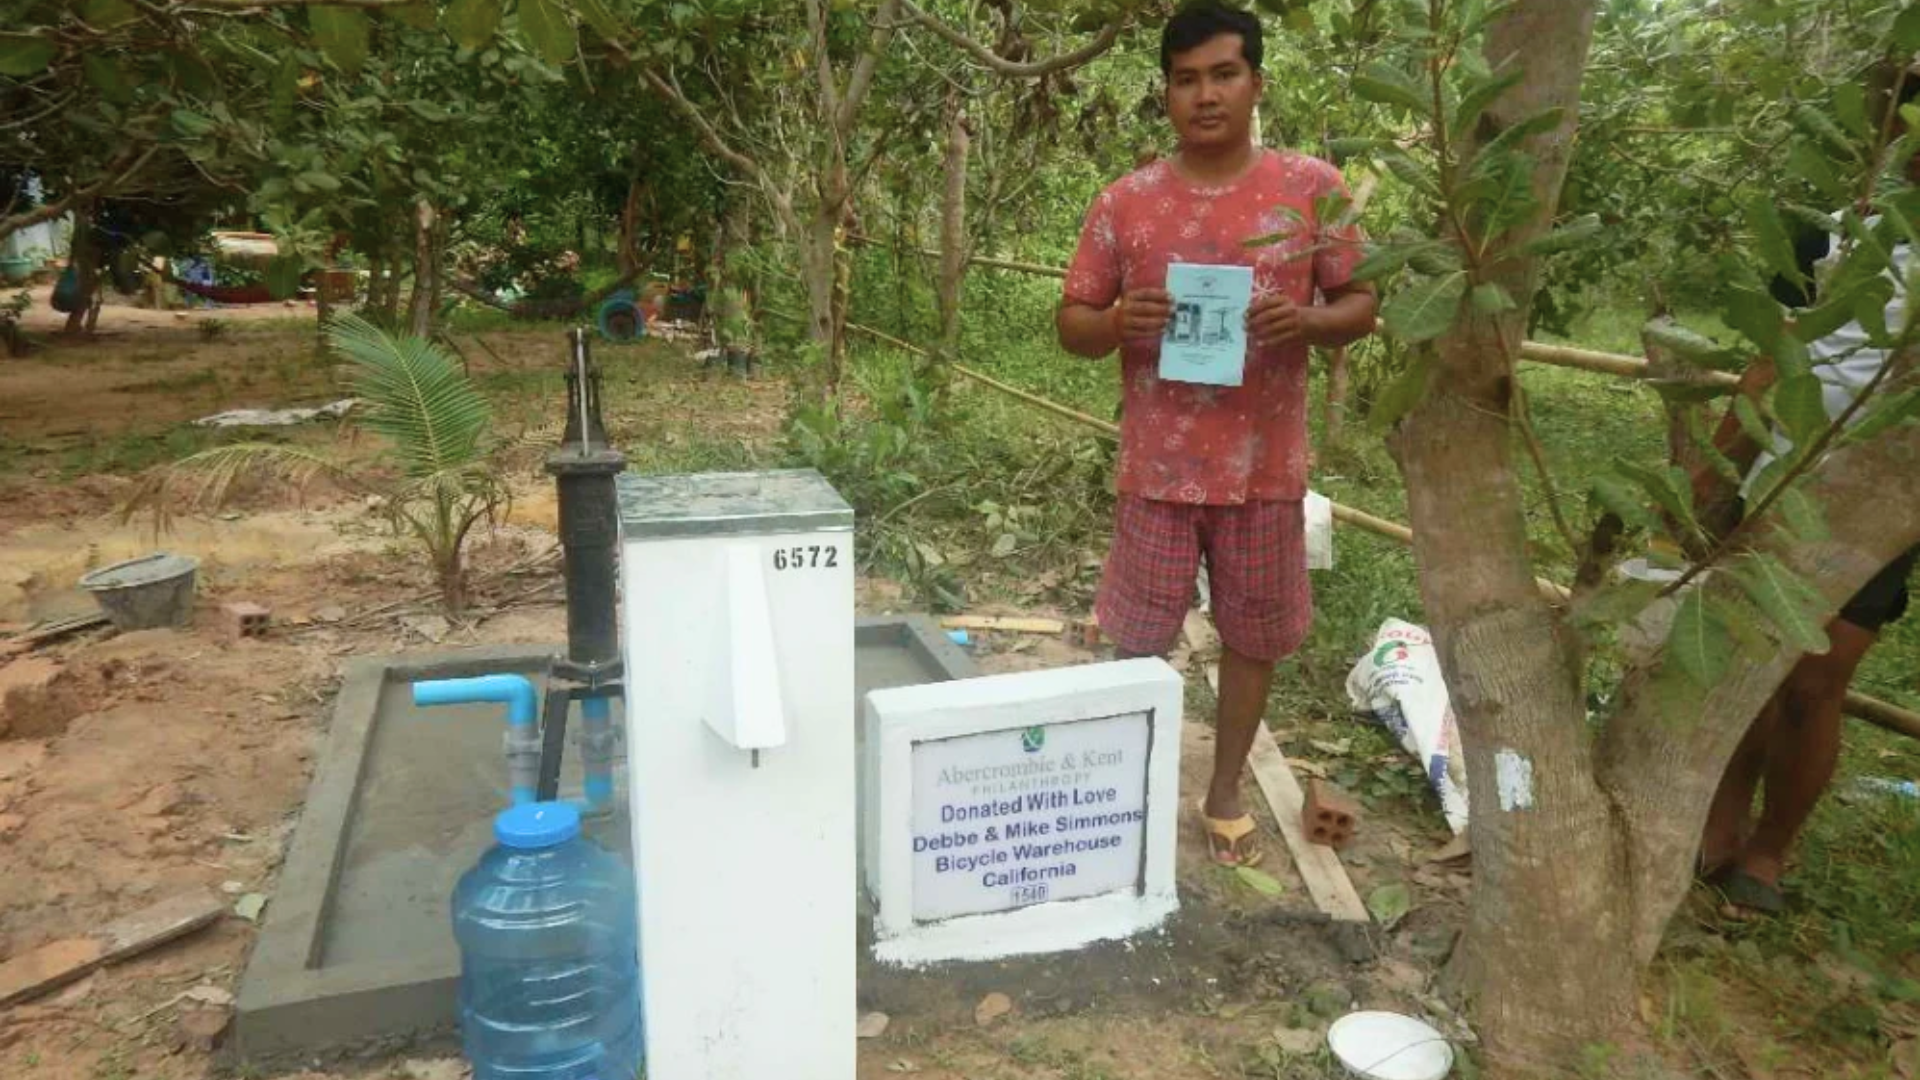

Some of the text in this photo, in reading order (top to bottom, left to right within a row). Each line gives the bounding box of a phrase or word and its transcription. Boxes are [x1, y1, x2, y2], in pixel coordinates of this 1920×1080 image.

[773, 545, 838, 571] 6572
[937, 749, 1123, 787] Abercrombie & Kent
[972, 773, 1092, 795] PHILANTHROPY
[941, 787, 1117, 823] Donated With Love
[912, 809, 1144, 853] Debbe & Mike Simmons
[935, 834, 1122, 873] Bicycle Warehouse
[982, 862, 1077, 888] California
